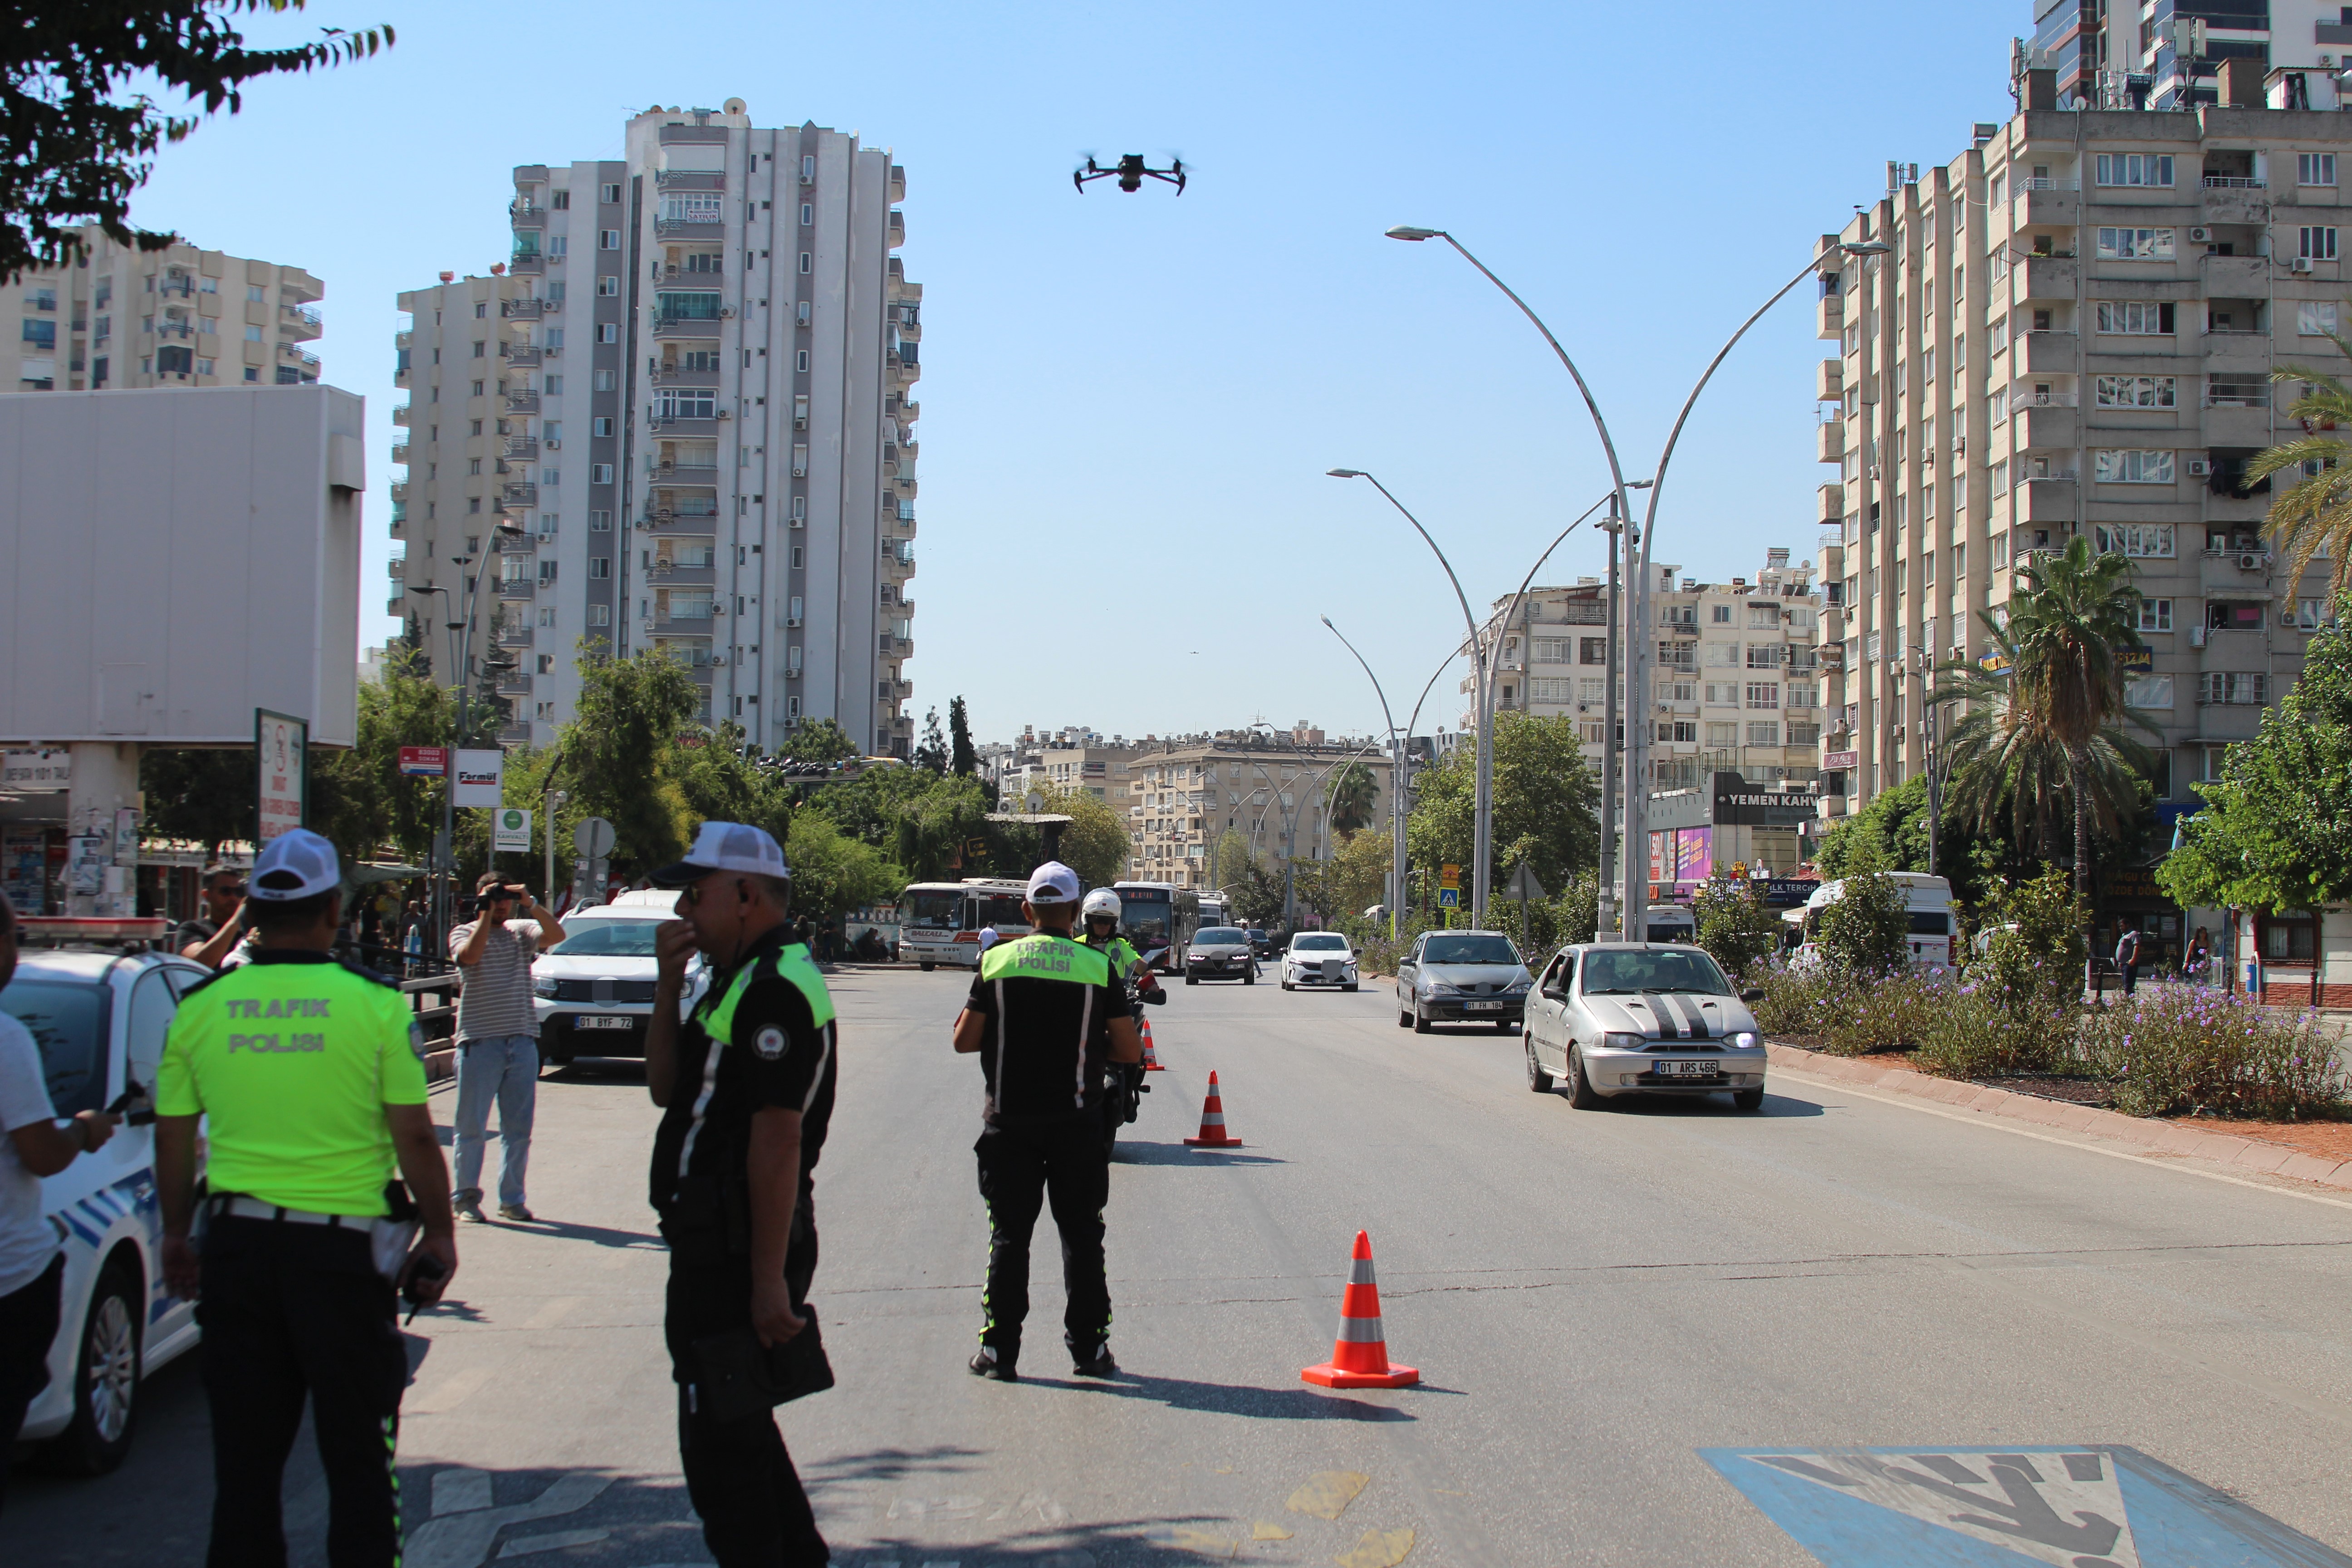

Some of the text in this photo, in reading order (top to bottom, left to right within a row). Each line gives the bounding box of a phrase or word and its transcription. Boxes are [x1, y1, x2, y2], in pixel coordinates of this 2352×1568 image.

[459, 772, 497, 780] Formül
[1729, 794, 1778, 806] YEMEN
[1652, 835, 1660, 857] 50
[1016, 941, 1075, 957] TRAFİK
[1019, 957, 1070, 973] POLİSİ
[580, 1017, 632, 1027] 01 BYF 72
[1661, 1063, 1716, 1073] 01 ARS 466
